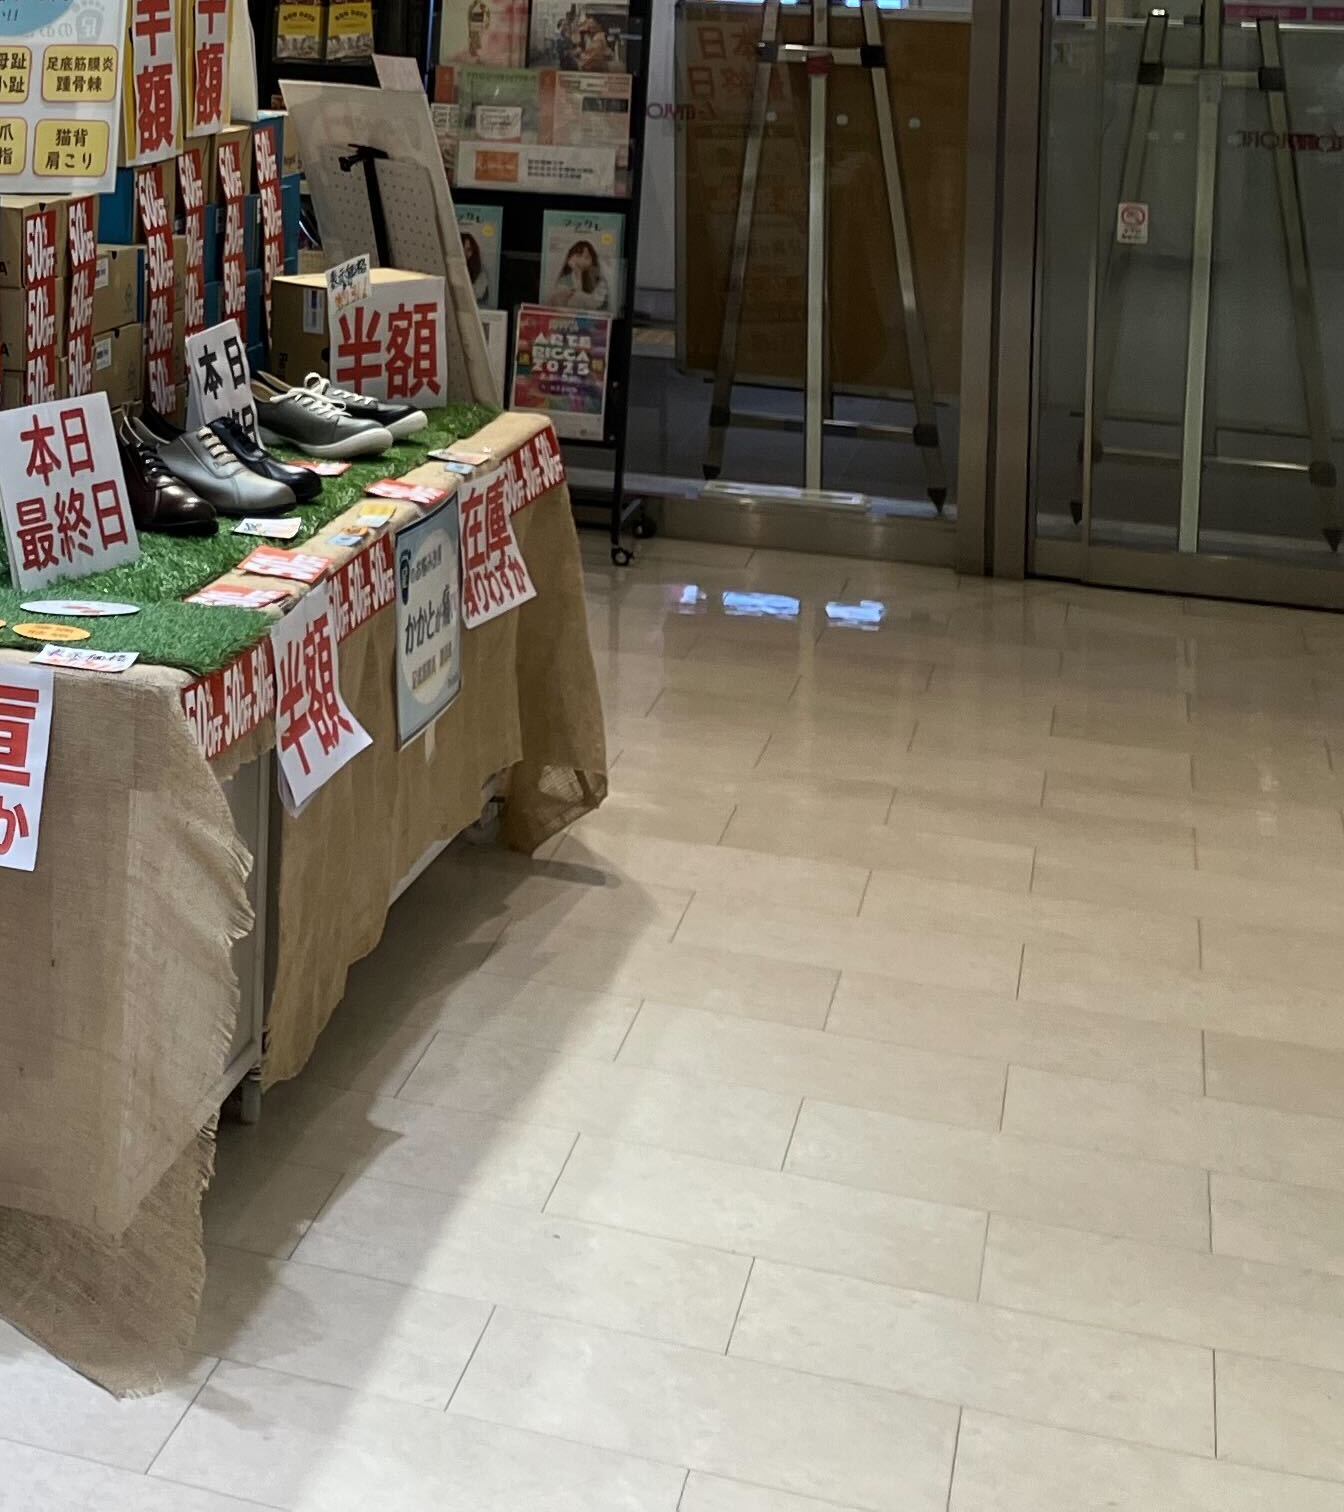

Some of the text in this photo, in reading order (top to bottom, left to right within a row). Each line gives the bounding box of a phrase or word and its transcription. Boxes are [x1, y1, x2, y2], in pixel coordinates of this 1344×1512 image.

[46, 56, 113, 74] 足底筋膜炎
[45, 152, 93, 170] 肩こり
[55, 129, 88, 147] 猫背
[198, 335, 247, 400] 本日
[336, 301, 441, 402] 半額
[532, 361, 591, 376] 2025
[19, 407, 95, 486] 本日
[16, 480, 130, 573] 最終日
[461, 476, 514, 568] 在庫
[280, 613, 354, 775] 半額
